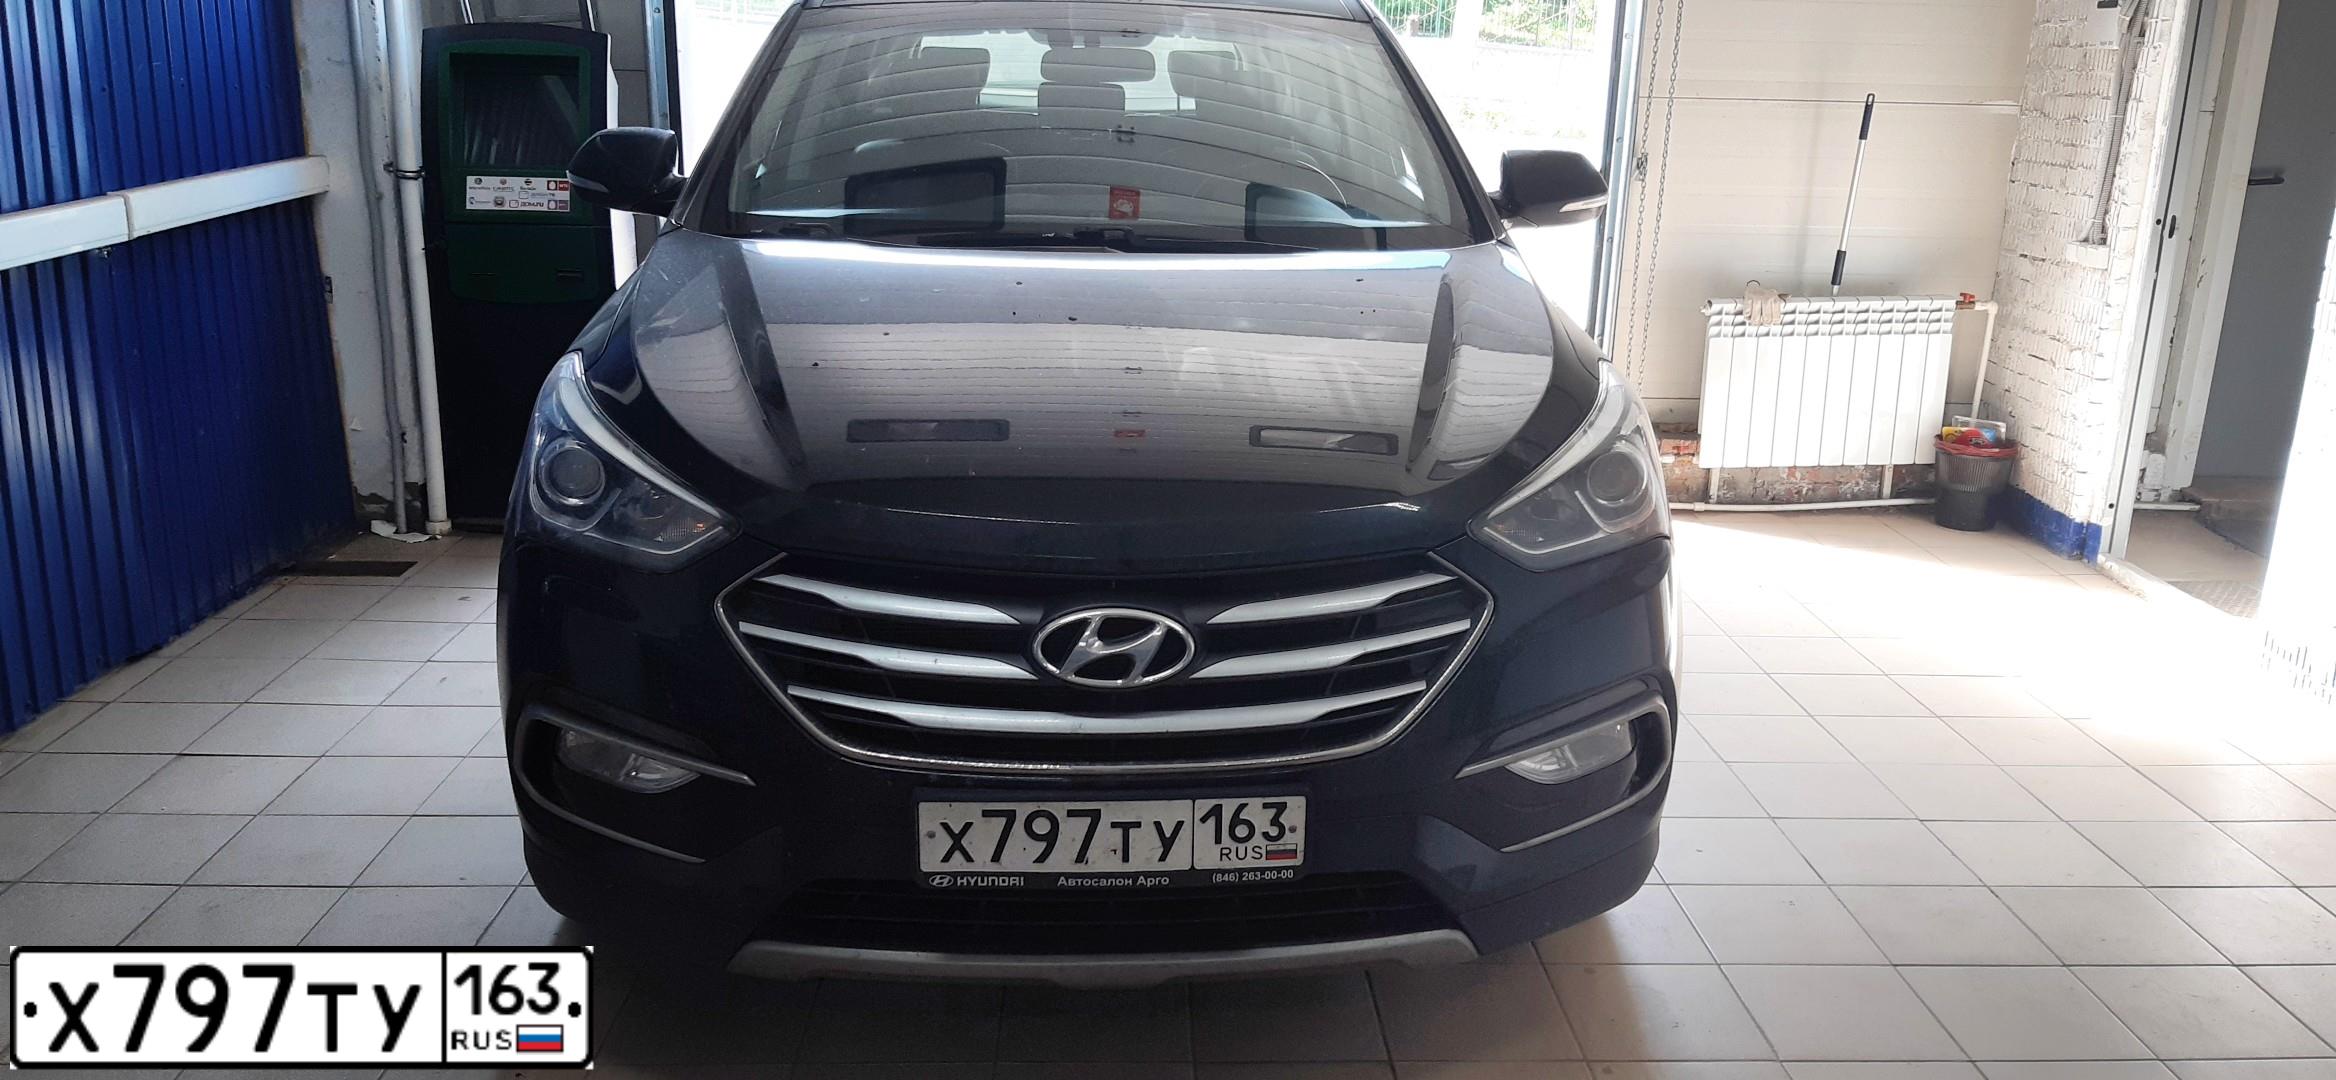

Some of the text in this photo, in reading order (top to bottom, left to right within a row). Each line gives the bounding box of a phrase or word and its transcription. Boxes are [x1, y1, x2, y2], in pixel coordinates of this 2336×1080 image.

[940, 801, 1289, 864] Х797ТУ 163
[1219, 845, 1264, 862] RUS
[956, 875, 1025, 887] HYUNDAI
[1056, 875, 1170, 888] Автосалон Арго
[1212, 869, 1295, 883] (846) 263-00-00
